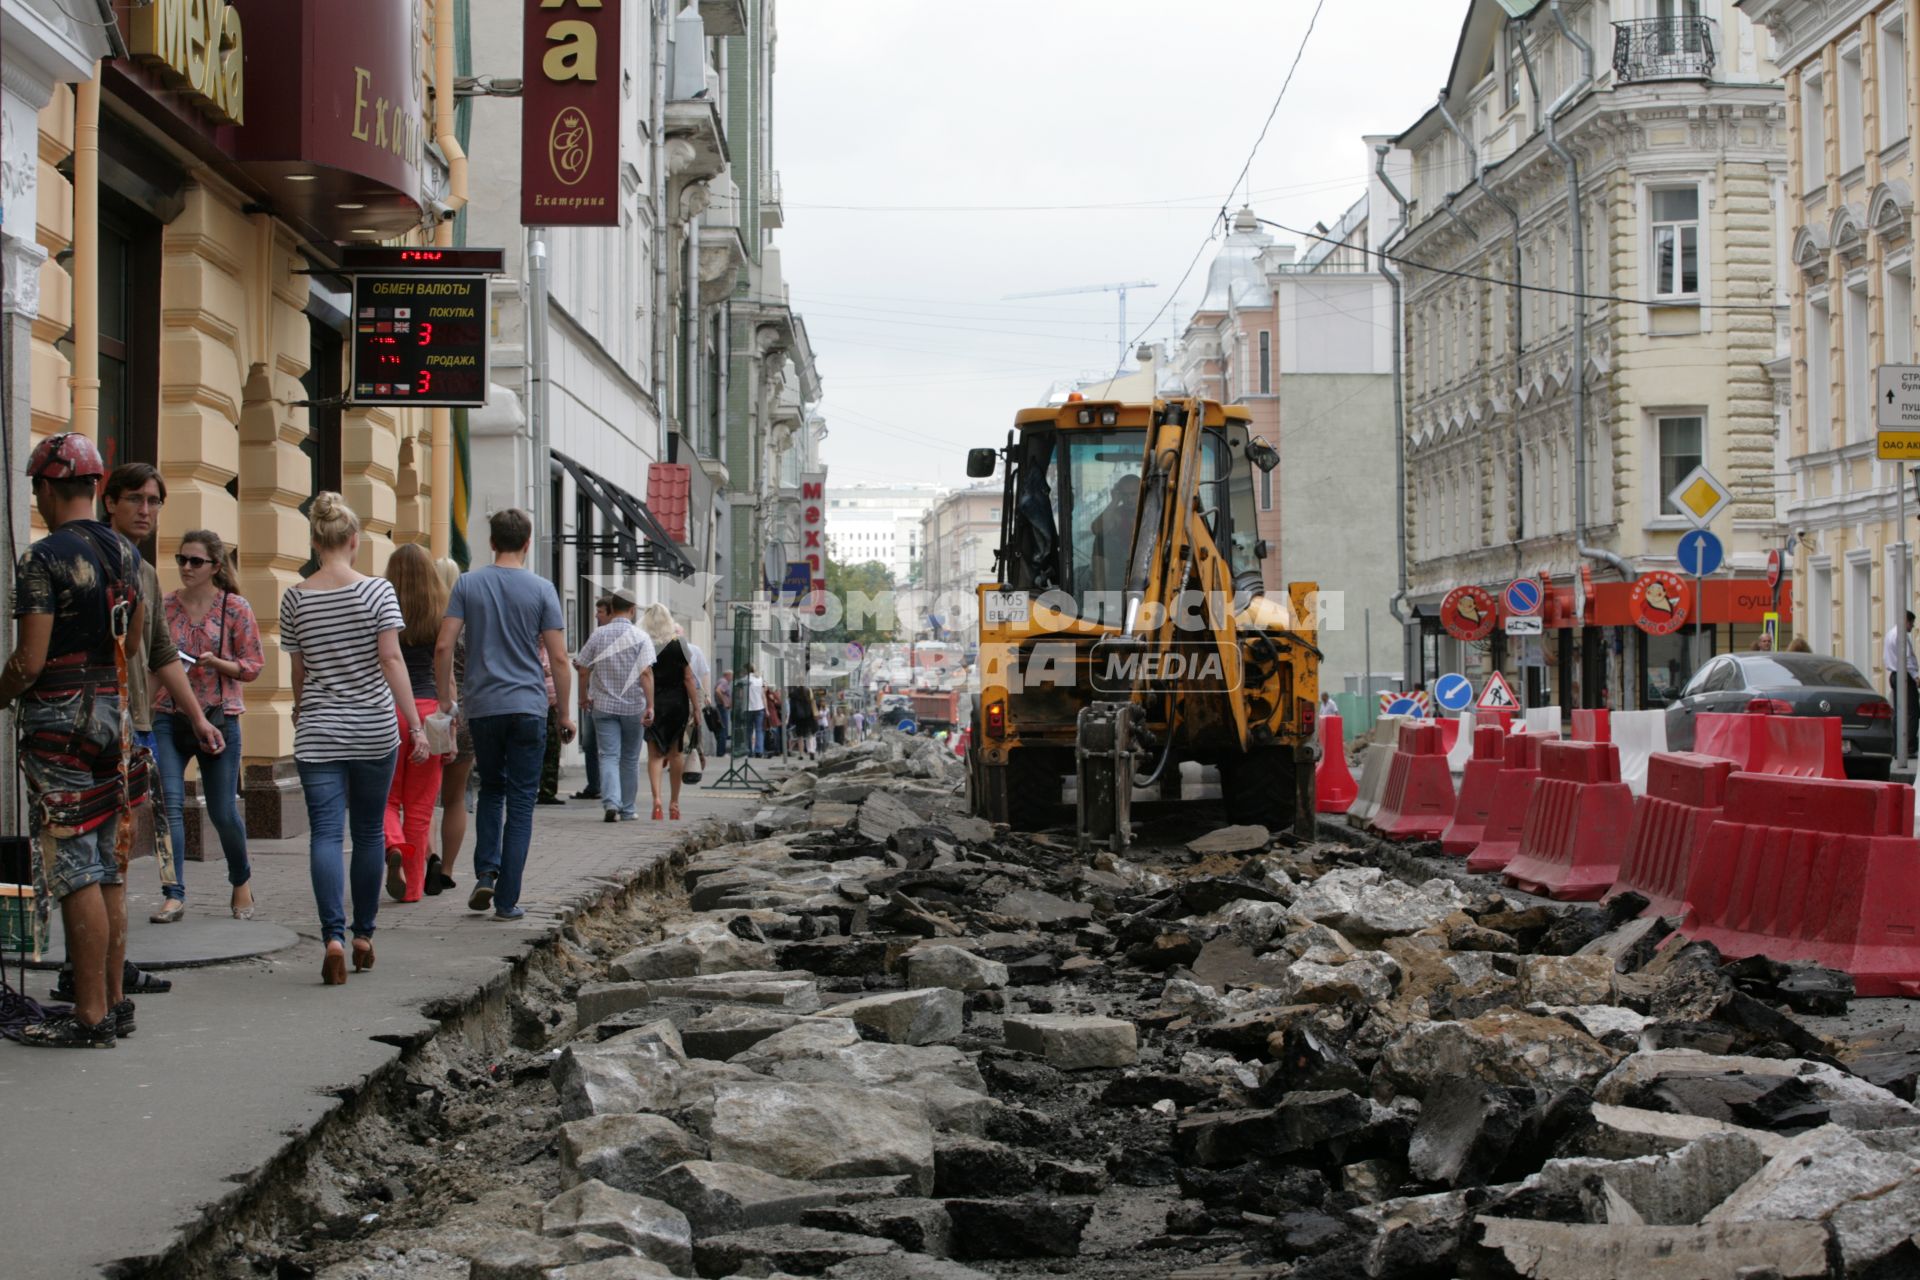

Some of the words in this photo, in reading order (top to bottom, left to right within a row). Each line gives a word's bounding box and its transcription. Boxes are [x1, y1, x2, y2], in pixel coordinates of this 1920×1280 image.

[534, 194, 605, 209] Екатерина
[372, 282, 413, 295] ОБМЕН
[416, 283, 471, 296] ВАЛЮТЫ
[429, 307, 475, 318] ПОКУПКА
[426, 355, 476, 367] ПРОДАЖА
[1901, 373, 1920, 381] СТР
[1883, 441, 1903, 449] ОАО
[991, 593, 1024, 607] 1105
